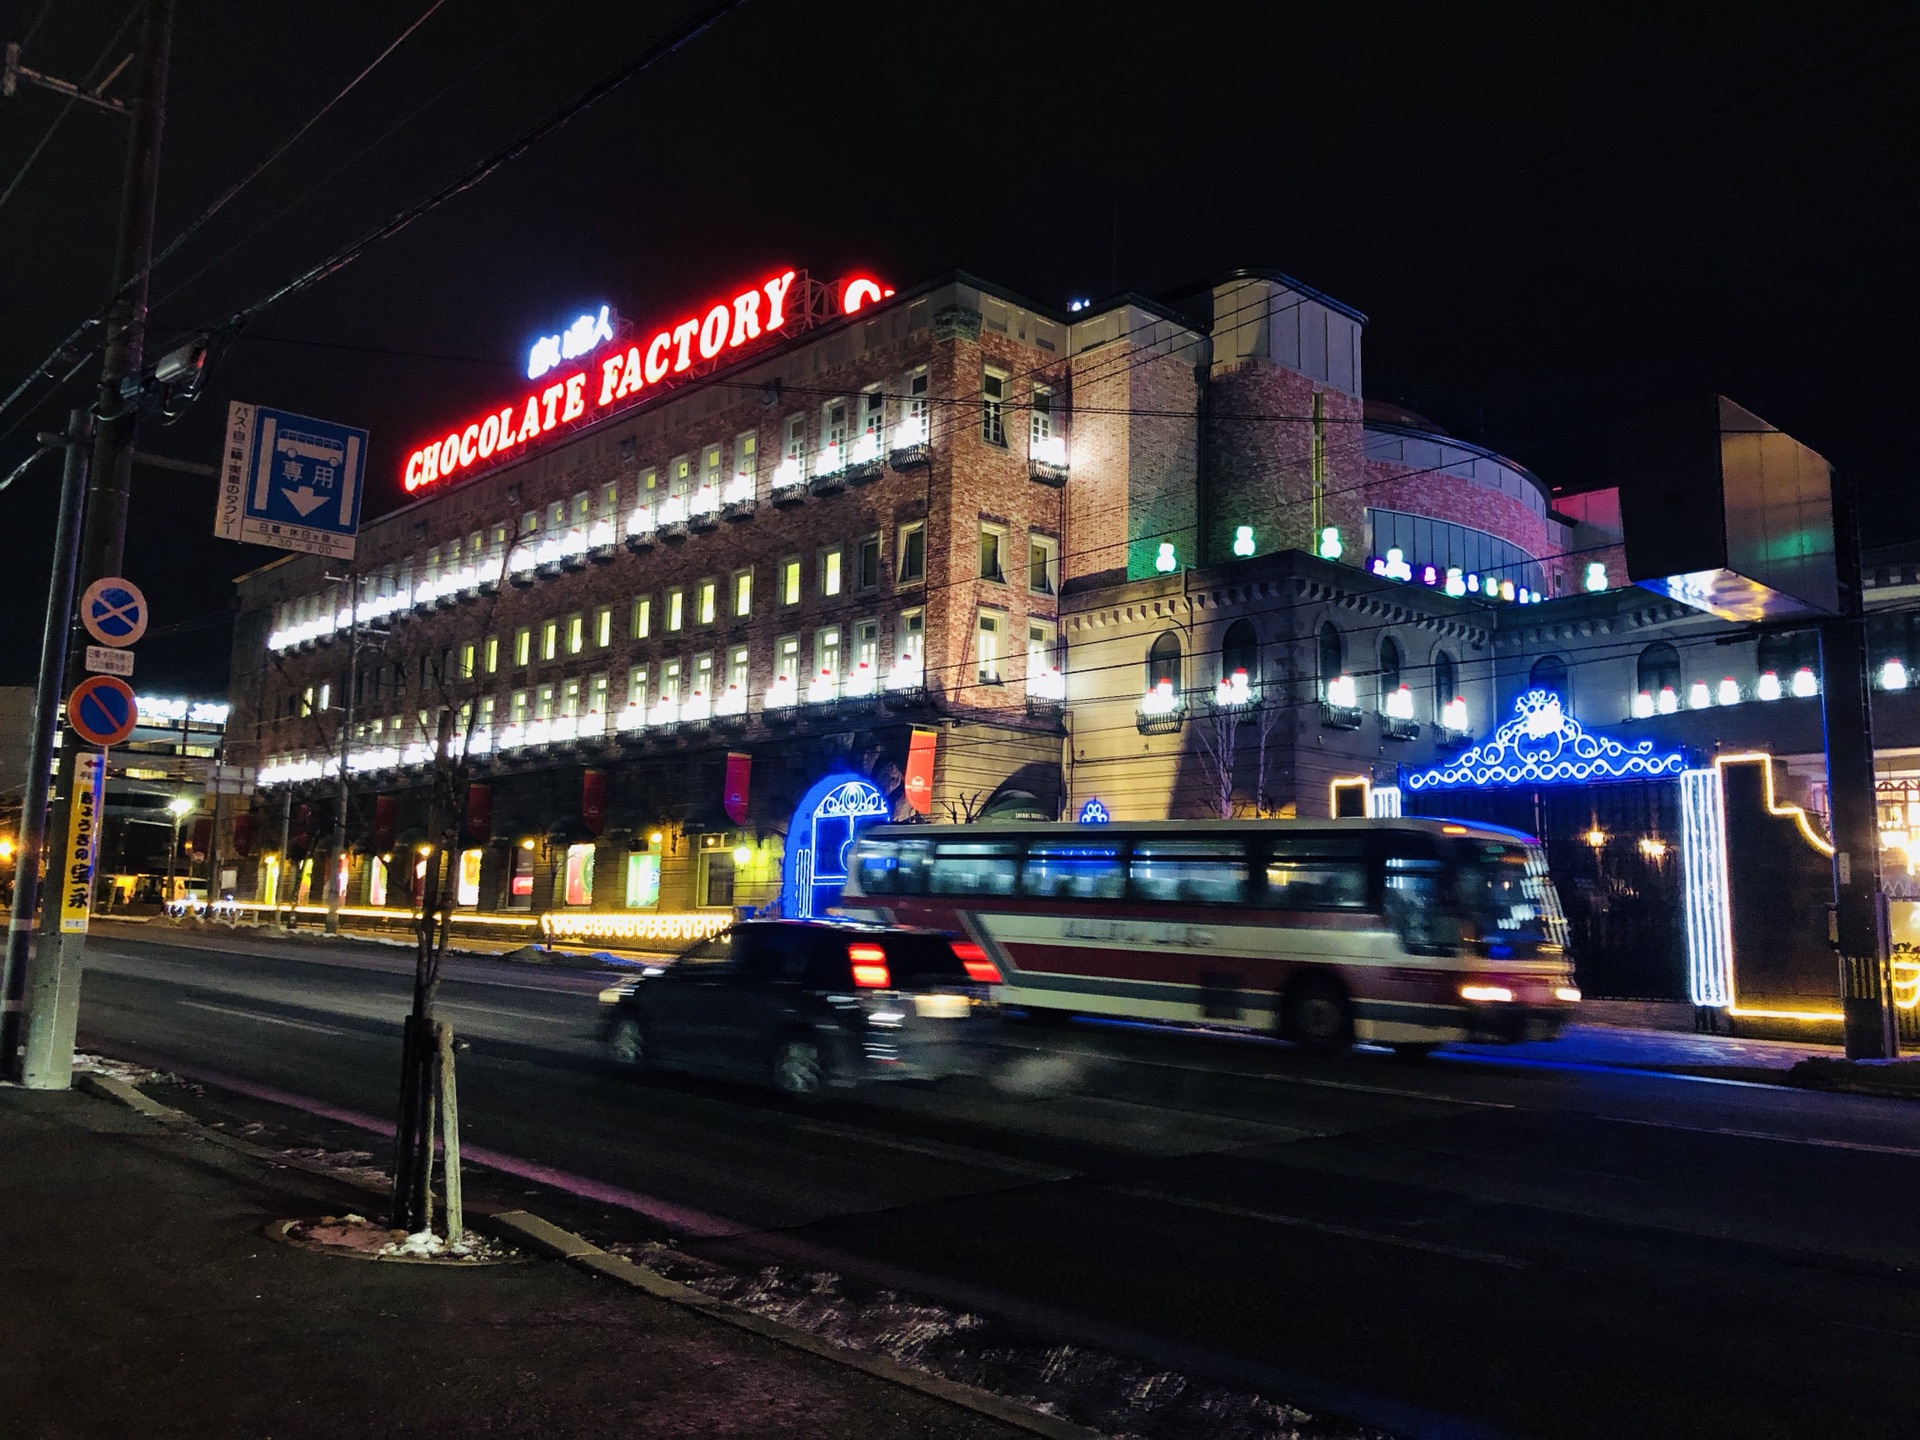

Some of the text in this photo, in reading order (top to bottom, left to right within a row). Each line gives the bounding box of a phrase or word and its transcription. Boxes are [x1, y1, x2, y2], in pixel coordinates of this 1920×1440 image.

[405, 373, 586, 491] CHOCOLATE
[598, 271, 796, 406] FACTORY
[282, 460, 334, 488] 専用
